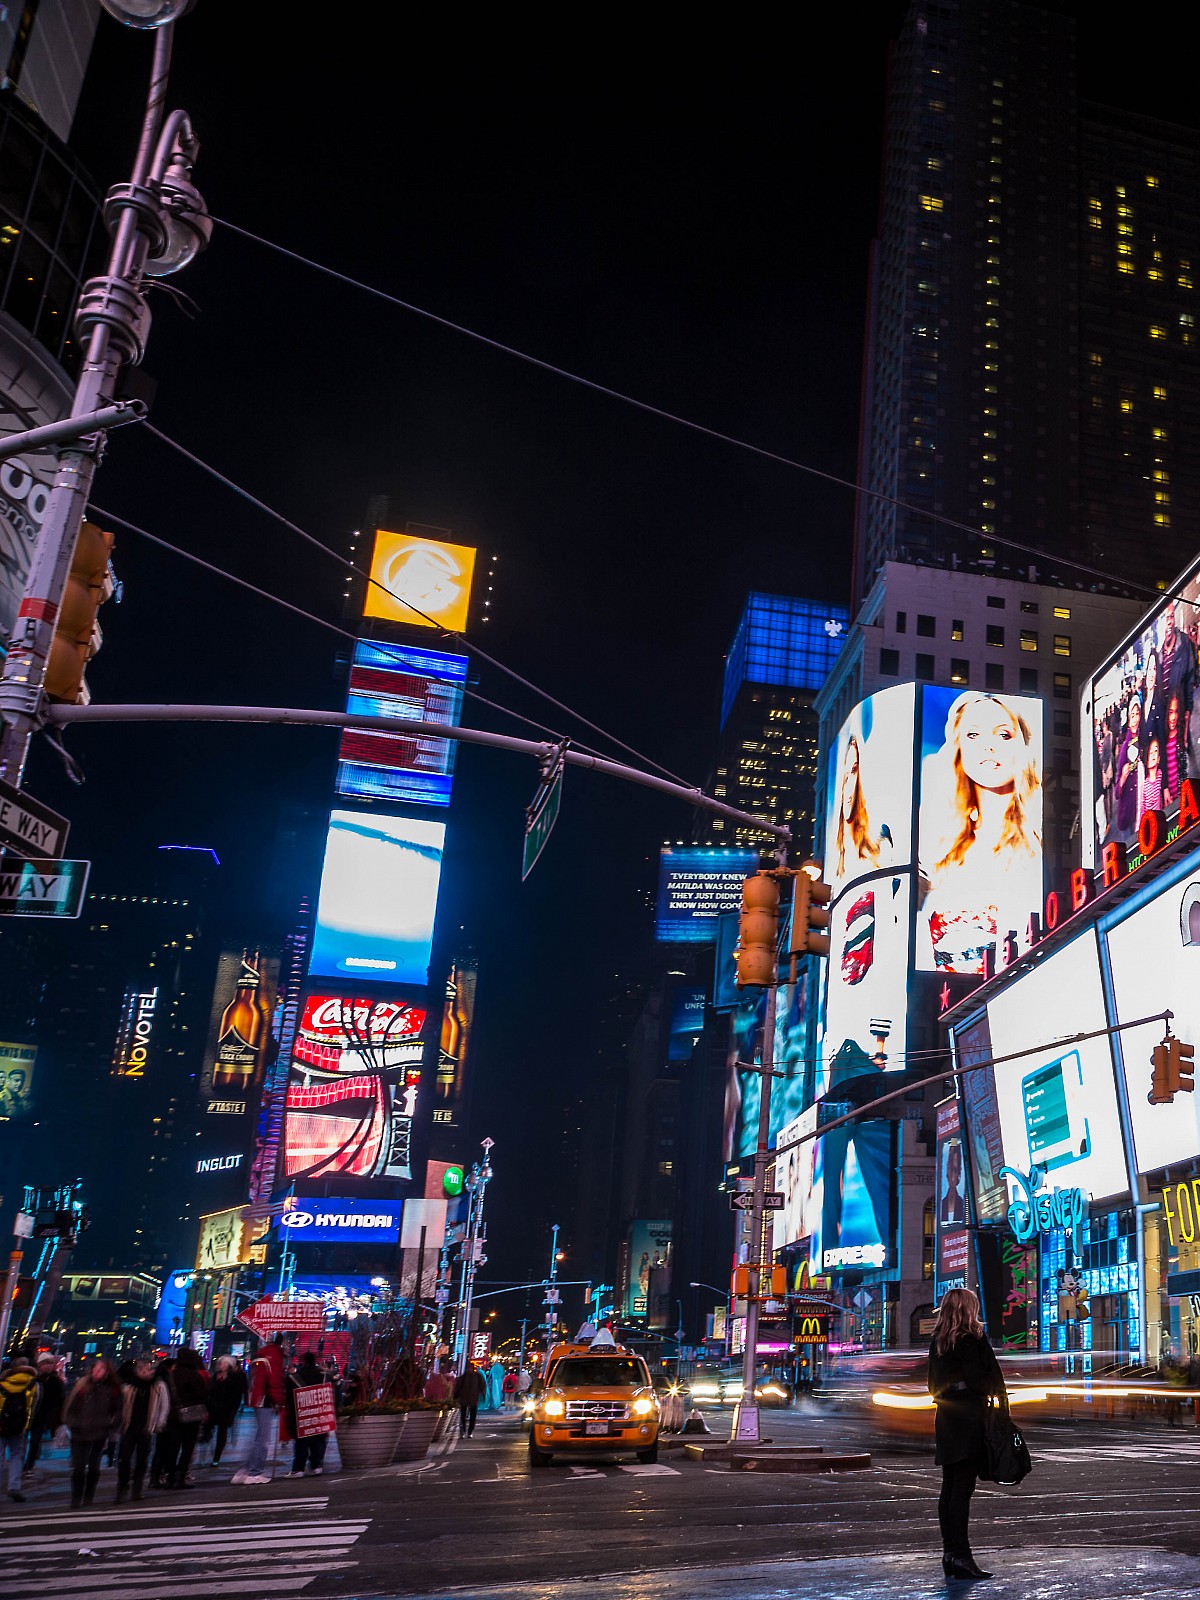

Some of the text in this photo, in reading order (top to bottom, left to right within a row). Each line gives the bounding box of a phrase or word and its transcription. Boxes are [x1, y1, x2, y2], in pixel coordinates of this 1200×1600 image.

[17, 811, 53, 848] WAY
[667, 882, 703, 890] MATILDA
[125, 986, 159, 1077] NOVOTEL
[207, 1102, 240, 1112] #TASTE
[196, 1154, 243, 1174] INGLOT
[741, 1196, 778, 1206] ON AY
[999, 1163, 1090, 1257] Disney
[315, 1213, 393, 1229] HYUNDAI
[794, 1292, 832, 1300] McDonald's
[254, 1303, 320, 1318] PRIVATE EYES
